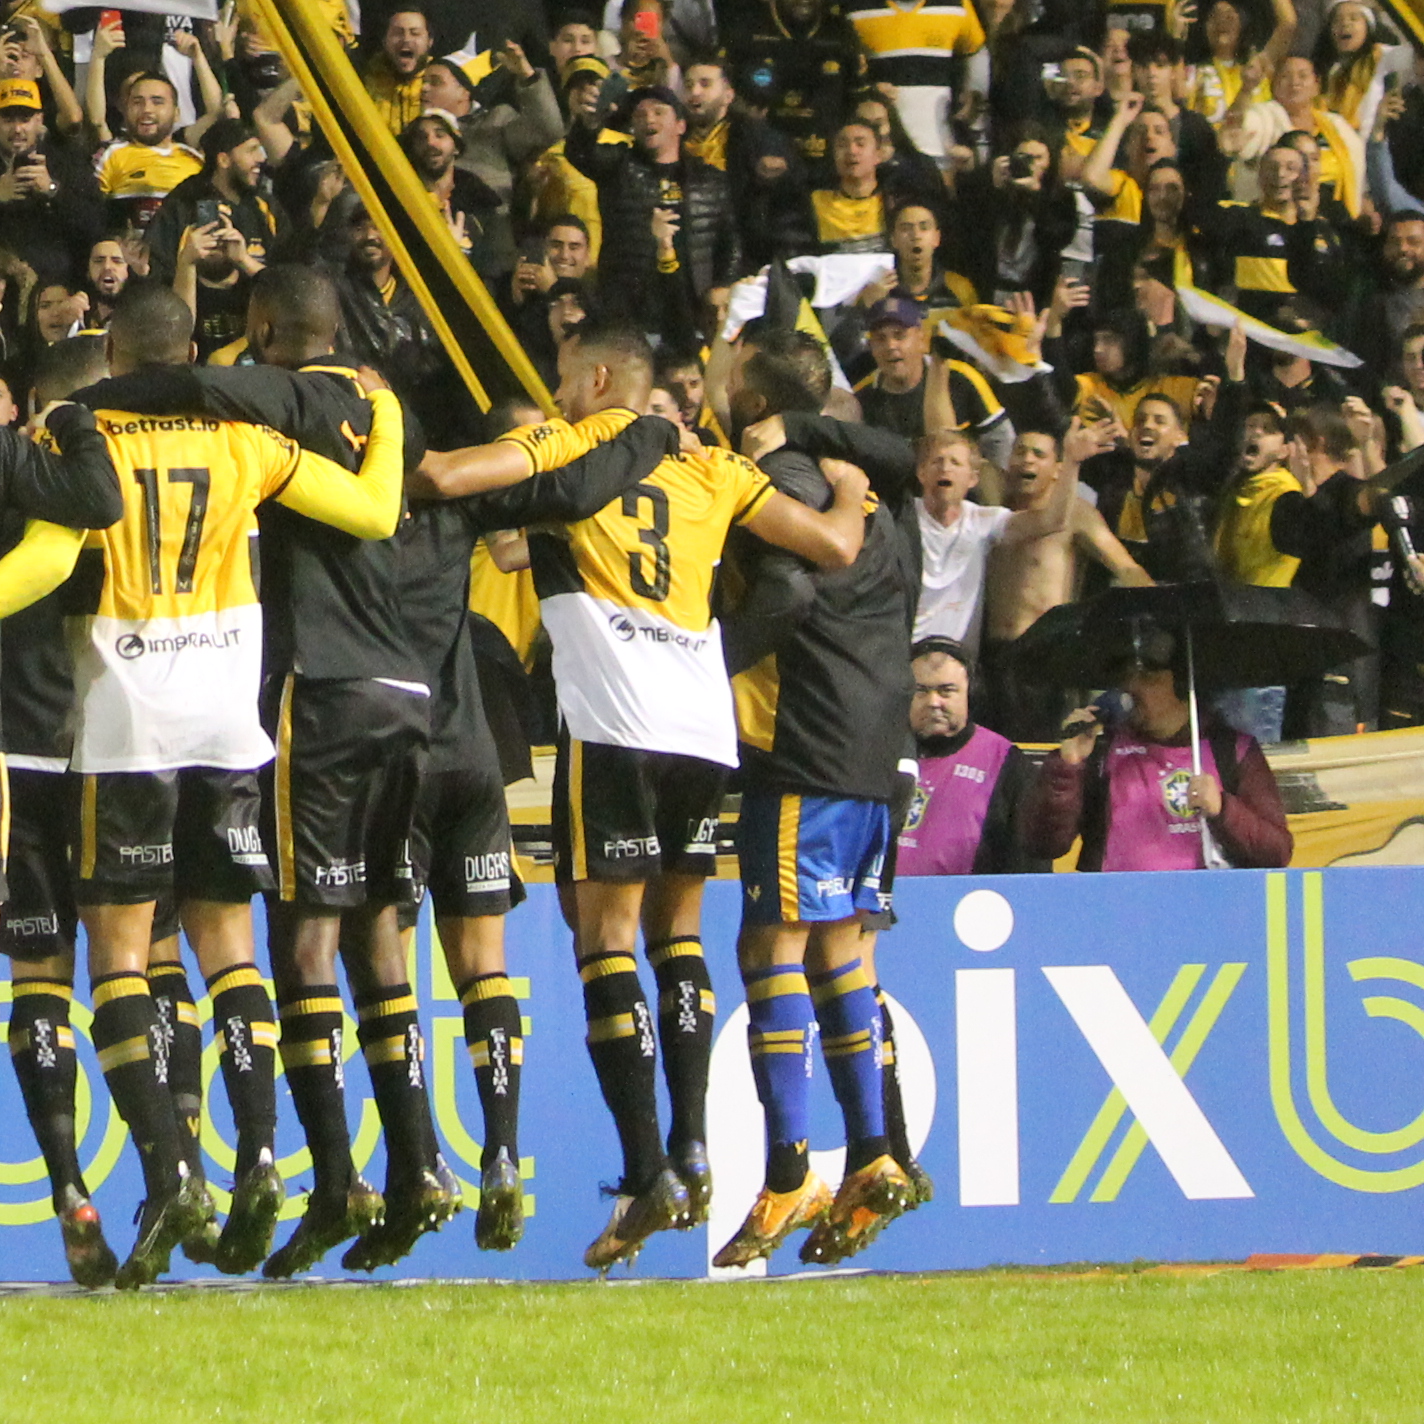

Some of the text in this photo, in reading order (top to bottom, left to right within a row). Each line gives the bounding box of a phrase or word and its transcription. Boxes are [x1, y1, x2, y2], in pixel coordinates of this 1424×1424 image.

[135, 468, 211, 596] 17
[620, 482, 670, 603] 3
[148, 628, 242, 654] IMBRALIT
[119, 843, 174, 866] PASTE
[604, 836, 662, 859] PASTE
[314, 861, 367, 886] PASTE
[464, 851, 510, 882] DUGAS
